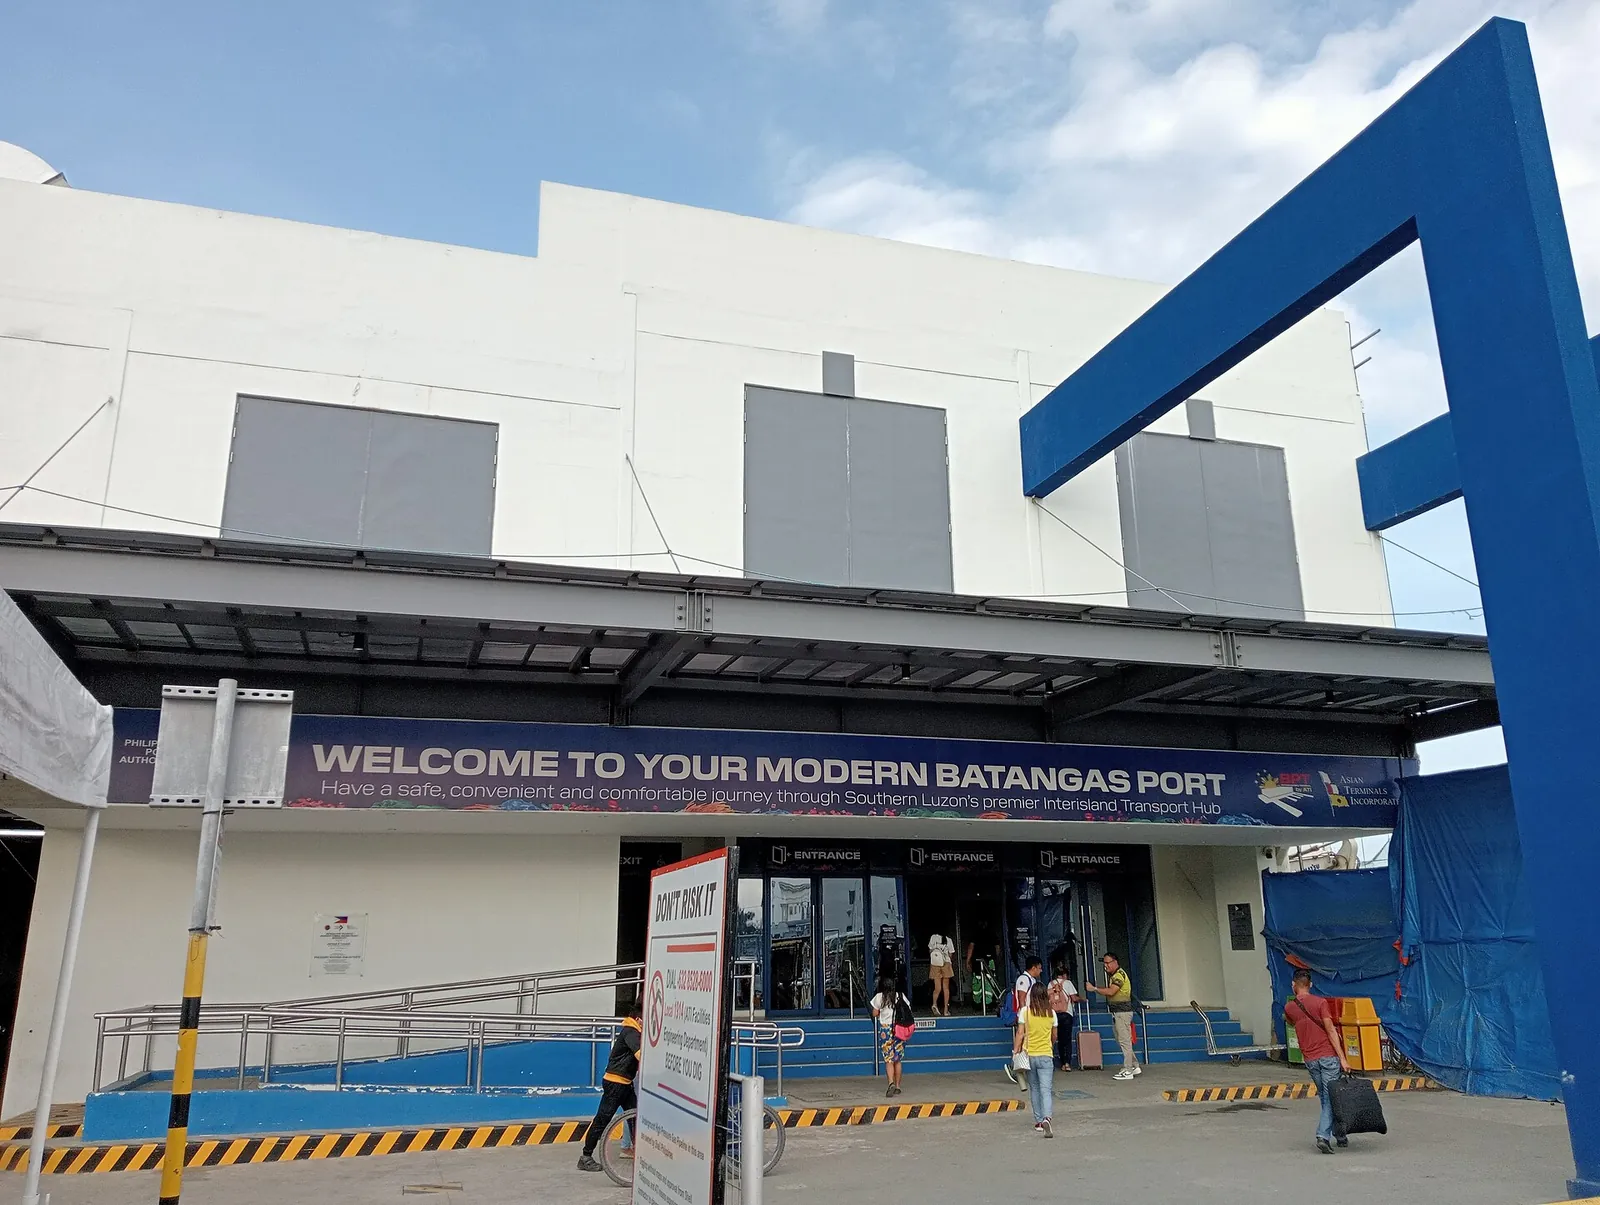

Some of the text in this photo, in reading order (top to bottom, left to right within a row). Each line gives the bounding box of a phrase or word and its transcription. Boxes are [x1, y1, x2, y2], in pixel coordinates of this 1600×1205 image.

[124, 739, 158, 747] PHILIP
[119, 756, 156, 764] AUTHO
[312, 744, 1226, 796] WELCOME TO YOUR MODERN BATANGAS PORT
[1279, 773, 1311, 784] BPT
[321, 780, 1221, 816] Have a safe, convenient and comfortable journey through Southern Luzon's premier Interisland Transport Hub
[794, 851, 861, 860] ENTRANCE
[931, 853, 994, 862] ENTRANCE
[1060, 855, 1120, 864] ENTRANCE
[655, 882, 717, 922] DON'T RISK IT
[665, 1052, 702, 1081] BEFORE YOU DIG
